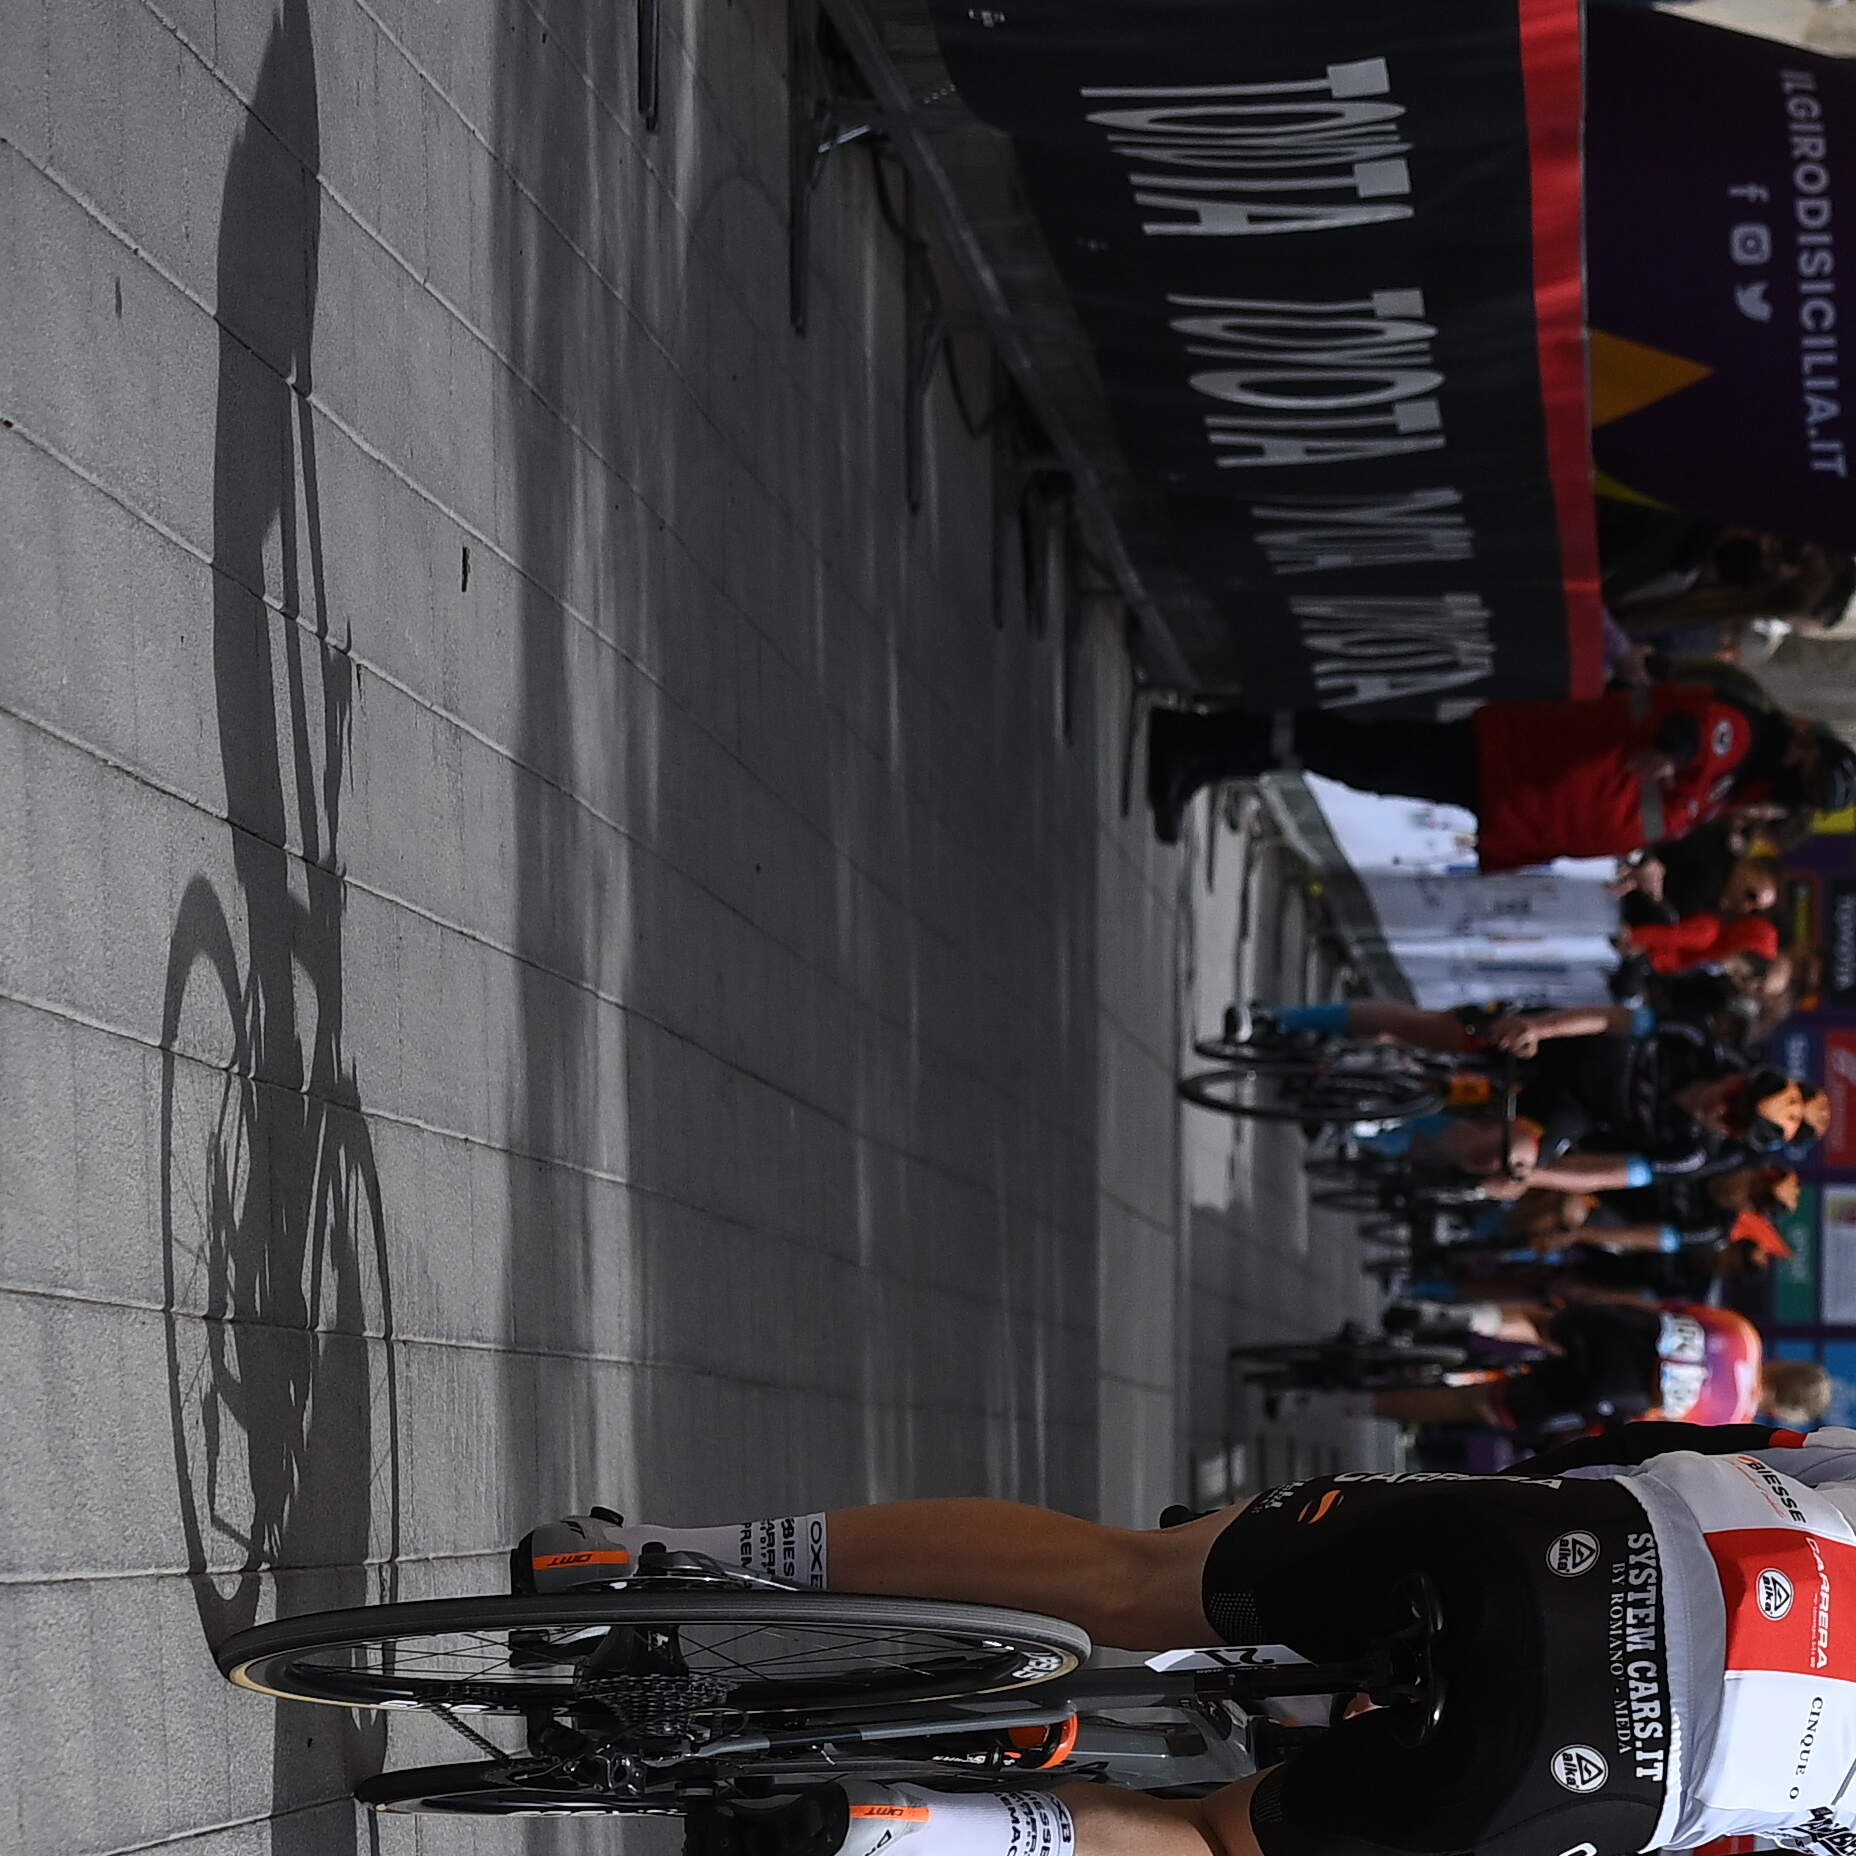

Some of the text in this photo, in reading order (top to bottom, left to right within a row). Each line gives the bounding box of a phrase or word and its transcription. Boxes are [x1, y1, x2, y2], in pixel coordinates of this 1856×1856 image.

[1780, 70, 1848, 479] ILGIRODISICILIA.IT
[1166, 288, 1447, 470] TOYOTA
[1748, 1462, 1807, 1525] BIESSE
[1611, 1562, 1627, 1586] BY
[1804, 1536, 1831, 1671] CARRERA
[1625, 1532, 1664, 1783] SYSTEM CARS.IT
[1612, 1700, 1633, 1755] MEDA
[1788, 1696, 1824, 1801] CINQUE O
